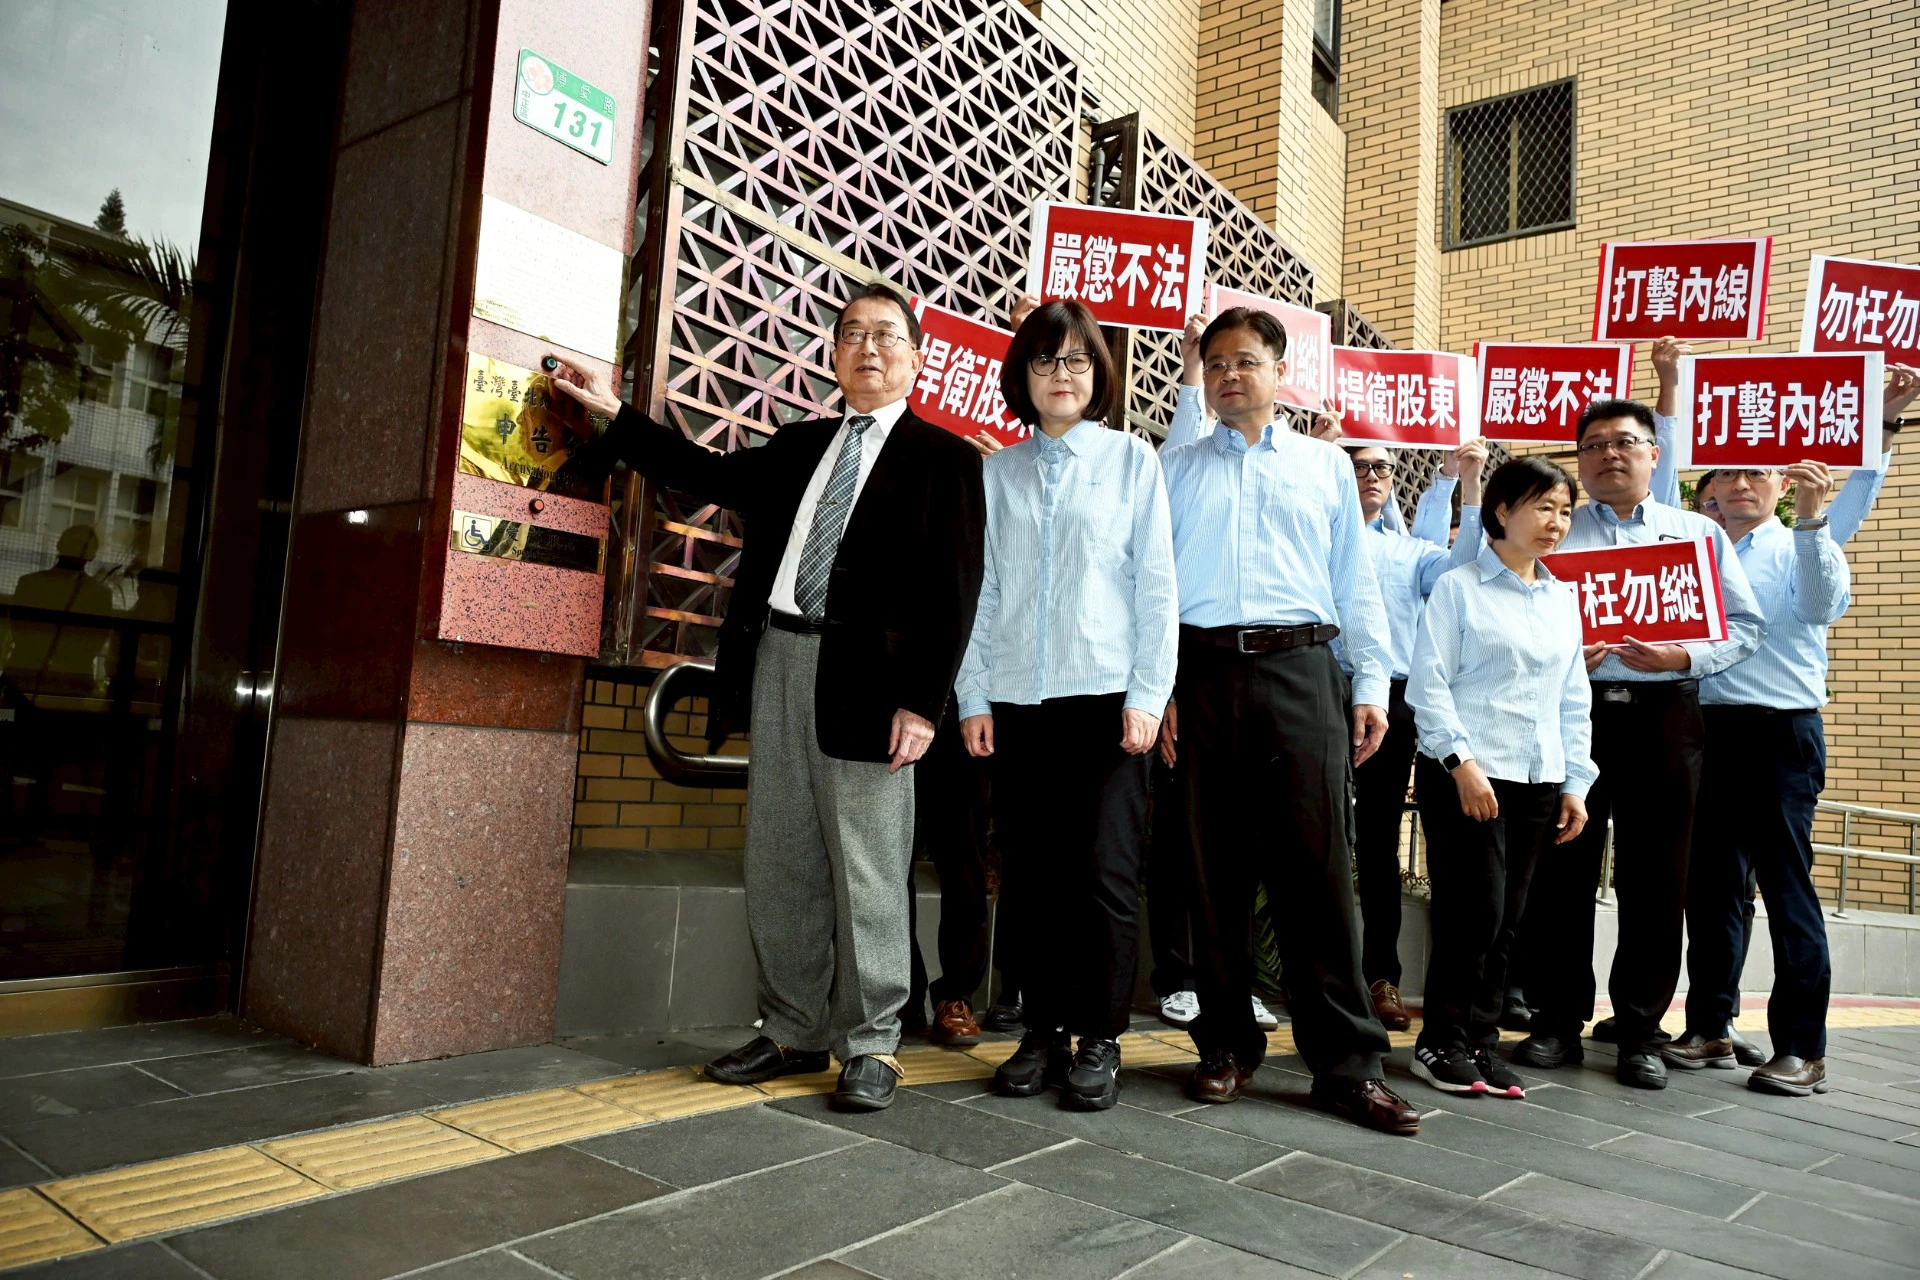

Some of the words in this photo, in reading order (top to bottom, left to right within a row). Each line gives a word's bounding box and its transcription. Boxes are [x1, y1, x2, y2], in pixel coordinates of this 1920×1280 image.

[554, 102, 603, 148] 131
[1045, 232, 1186, 312] 嚴懲不法
[1611, 263, 1749, 323] 打擊內線
[1820, 282, 1920, 351] 勿枉勿
[916, 332, 1035, 438] 捍衛股
[1336, 367, 1457, 429] 捍衛股東
[1697, 380, 1860, 447] 打擊內線
[501, 456, 556, 480] Accusation
